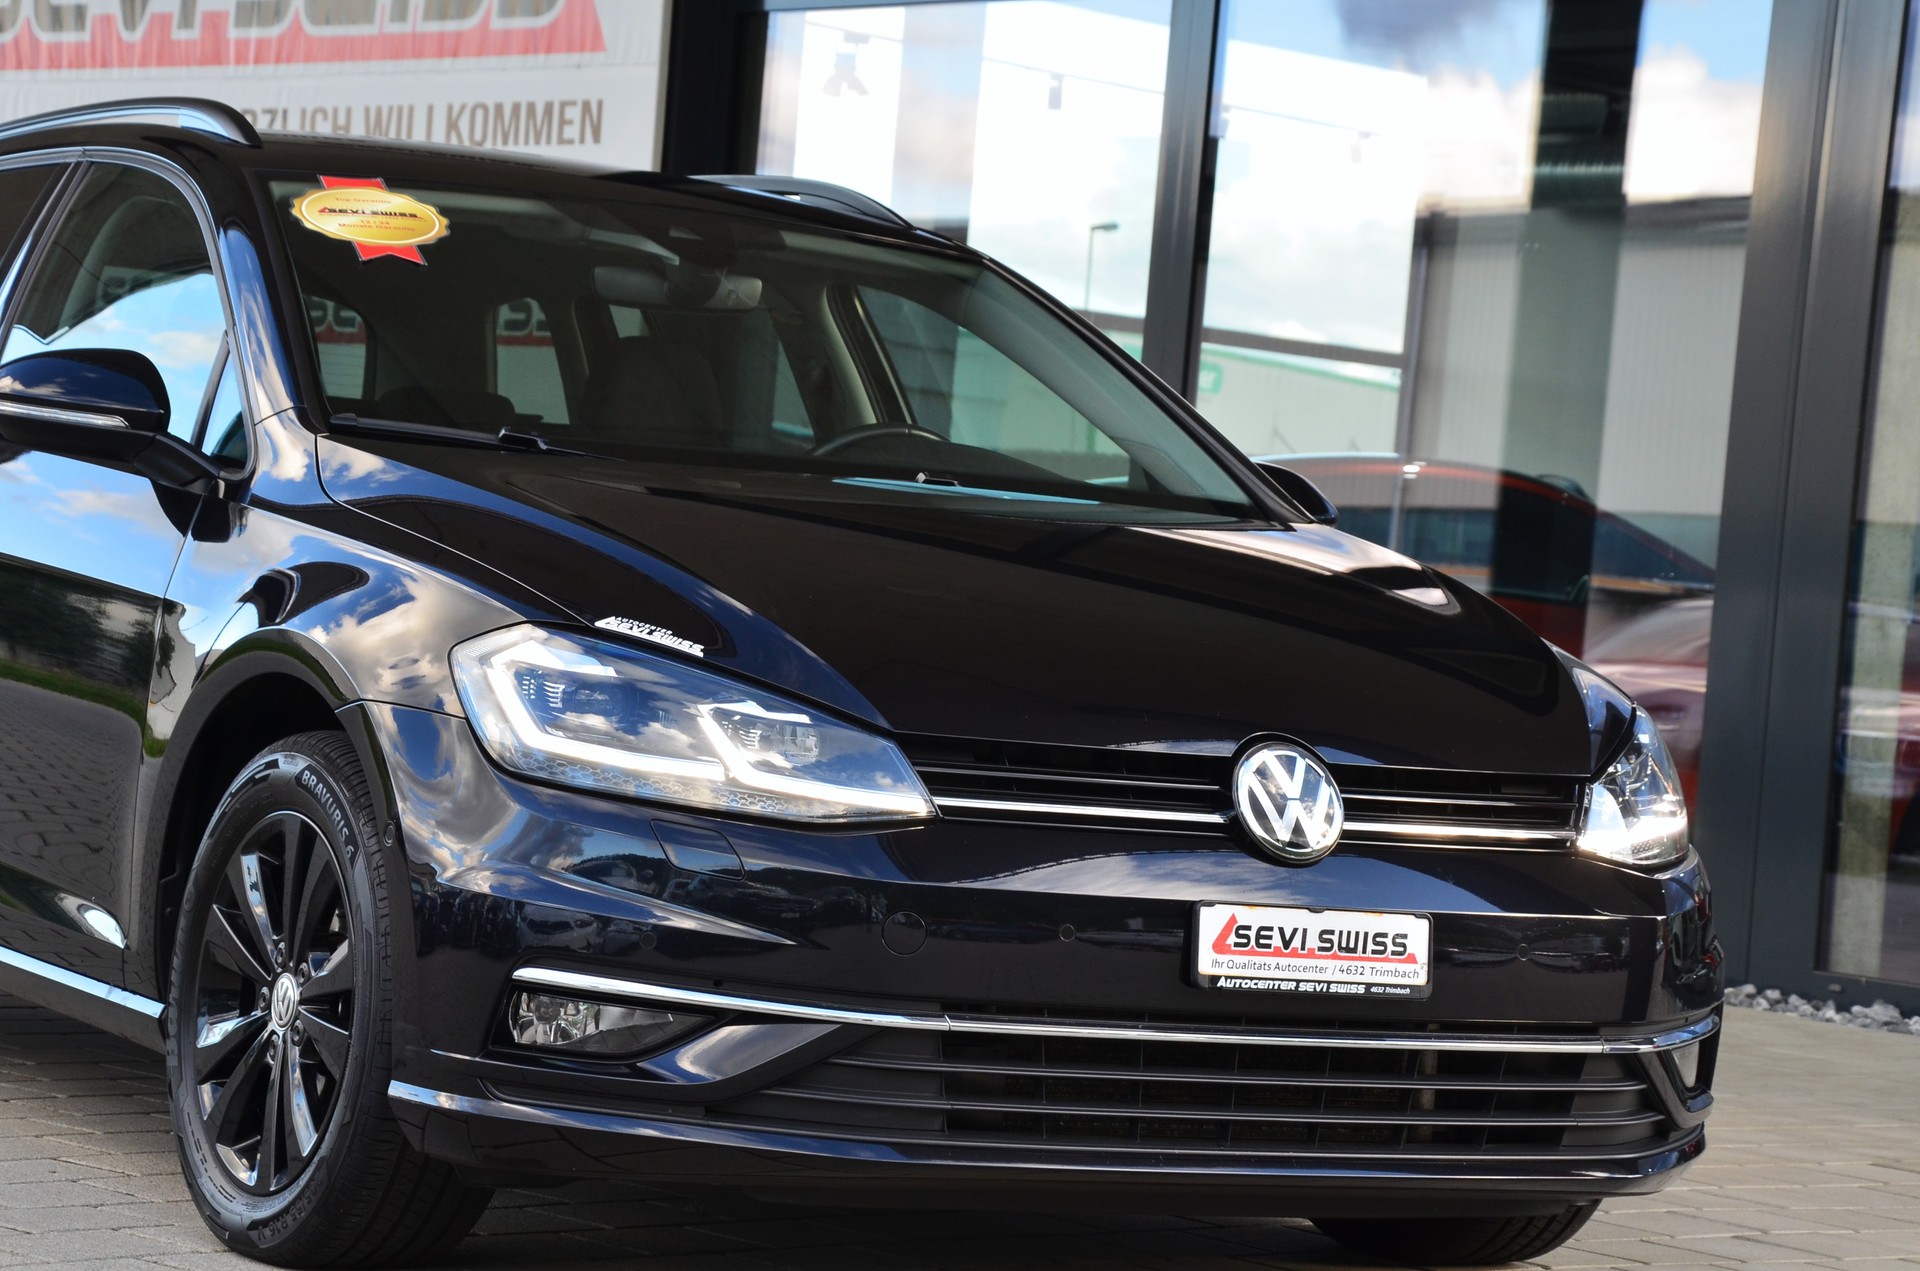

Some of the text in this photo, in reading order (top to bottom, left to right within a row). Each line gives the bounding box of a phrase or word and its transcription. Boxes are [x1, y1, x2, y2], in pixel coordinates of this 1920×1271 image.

[363, 98, 604, 146] WILLKOMMEN
[616, 616, 673, 635] AUTOCENTER
[301, 769, 354, 859] BRAVURIS 6
[1232, 924, 1409, 957] SEVI SWISS
[1211, 958, 1225, 969] Ihr
[1273, 961, 1329, 974] Autocenter
[1338, 964, 1365, 976] 4632
[1369, 966, 1420, 979] Trimbach
[1217, 976, 1411, 995] AUTOCENTER SEVI SWISS 4632 Trimbach
